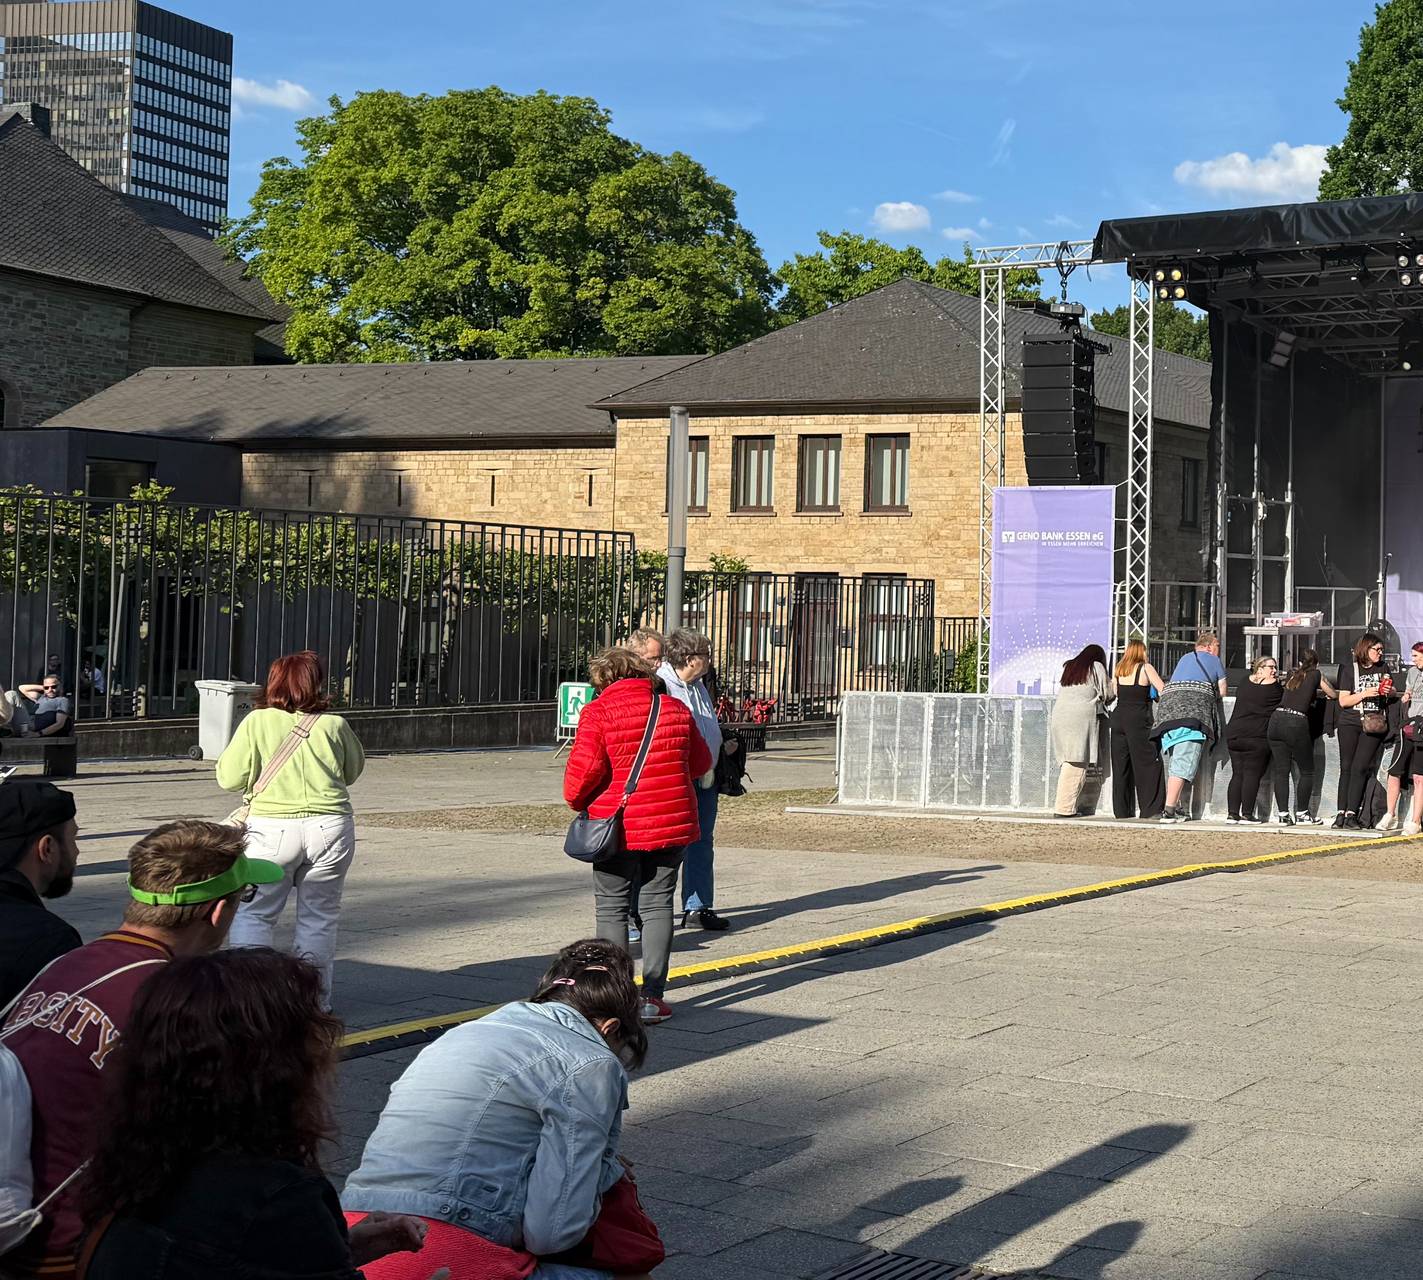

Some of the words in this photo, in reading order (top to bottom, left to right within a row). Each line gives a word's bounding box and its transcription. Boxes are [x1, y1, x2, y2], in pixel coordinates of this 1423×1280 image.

[1016, 531, 1040, 541] GENO
[1041, 531, 1064, 541] BANK
[1065, 531, 1091, 541] ESSEN
[1092, 531, 1104, 541] eG
